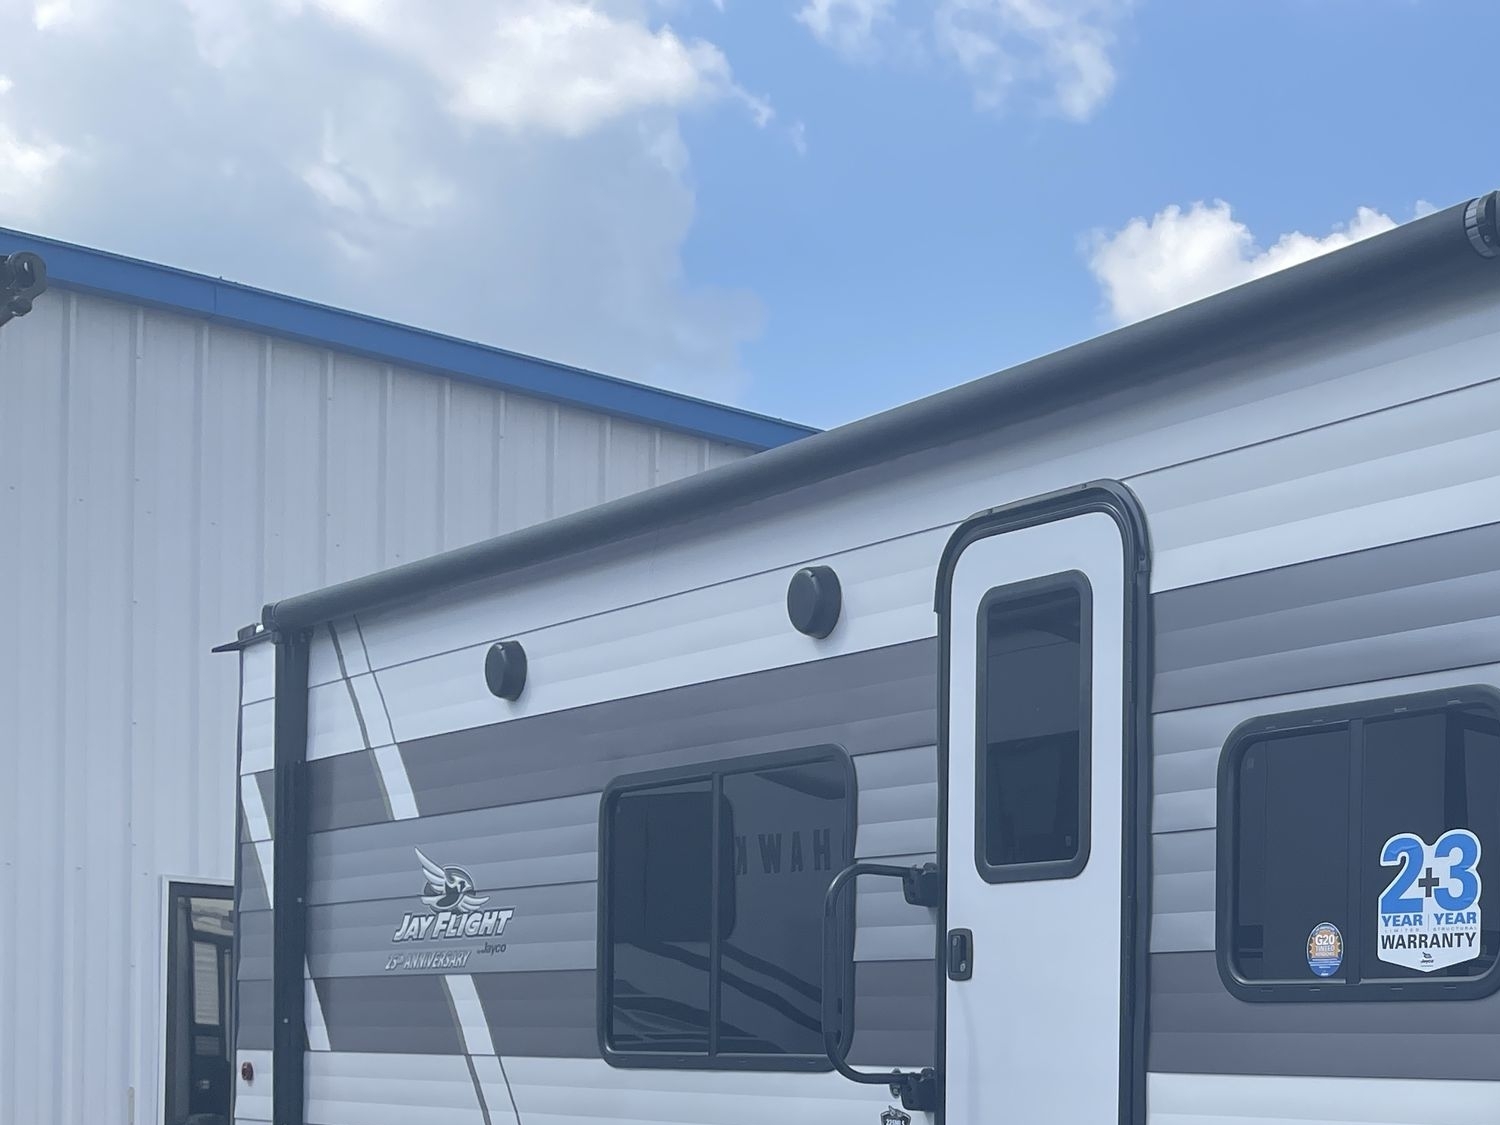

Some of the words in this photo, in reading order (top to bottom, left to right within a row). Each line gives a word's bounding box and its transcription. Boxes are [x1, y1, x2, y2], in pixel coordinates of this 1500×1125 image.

[393, 913, 435, 942] JAY
[431, 908, 514, 939] FLIGHT
[1381, 915, 1423, 927] YEAR
[1433, 912, 1477, 925] YEAR
[1315, 934, 1335, 945] G20
[1381, 932, 1476, 949] WARRANTY
[404, 950, 471, 969] ANNIVERSARY
